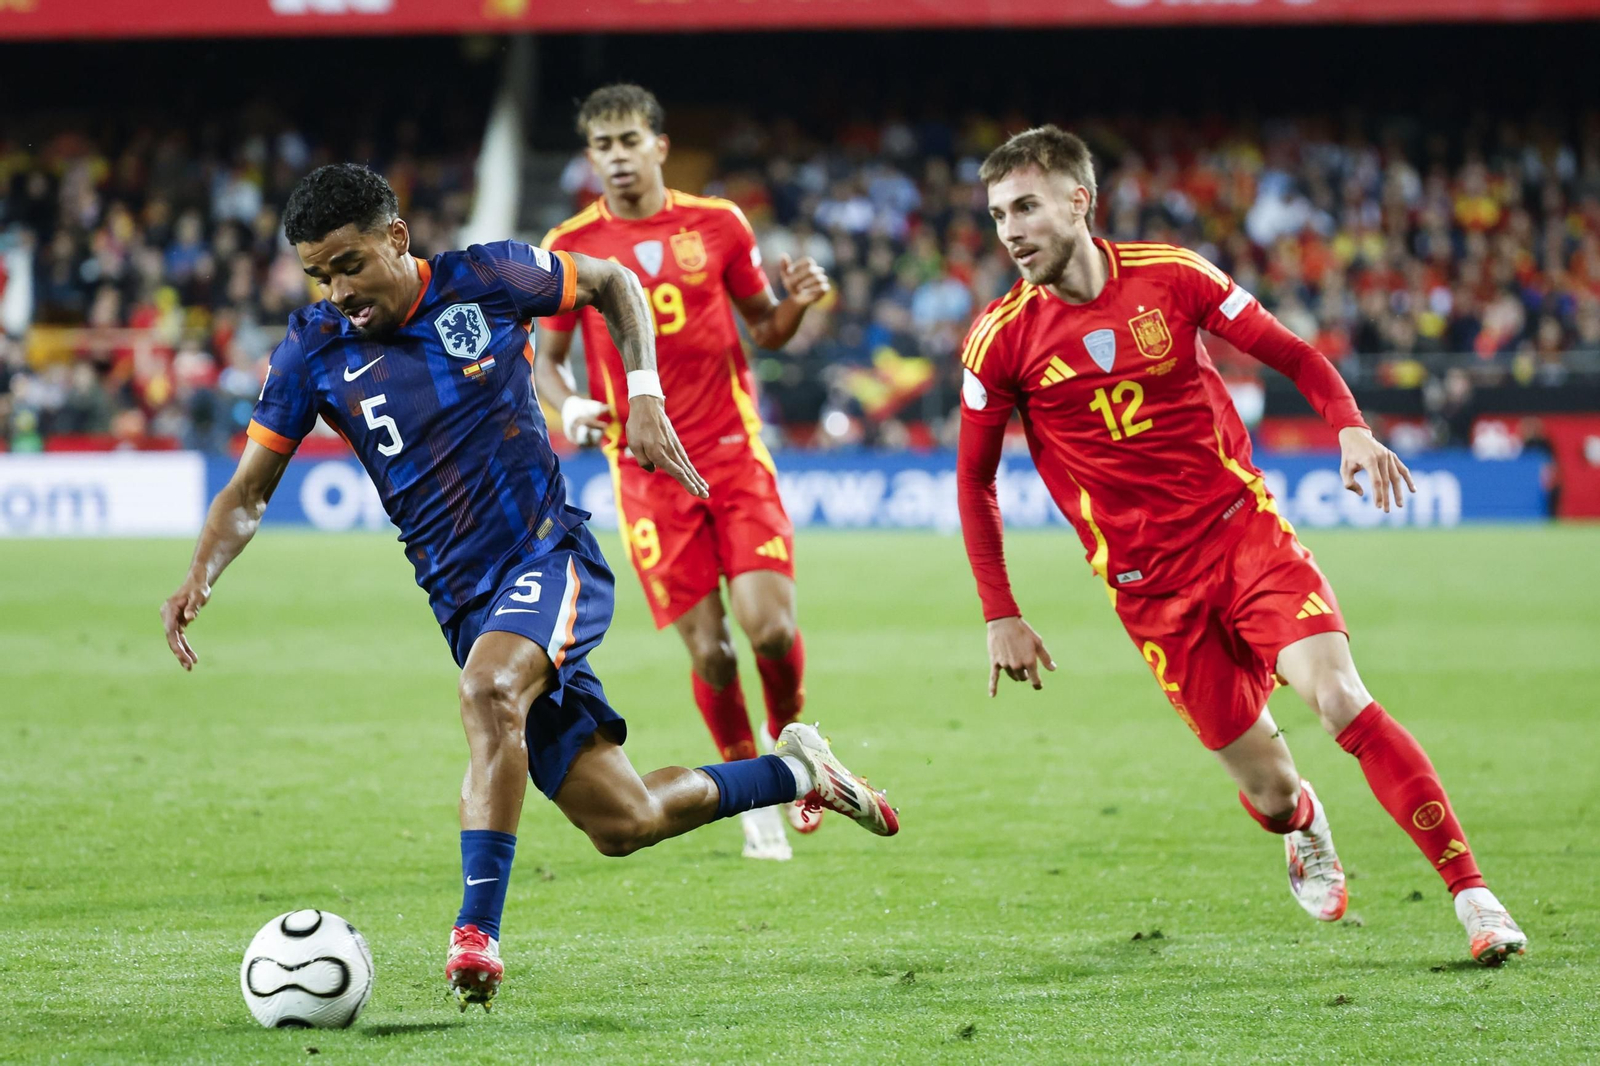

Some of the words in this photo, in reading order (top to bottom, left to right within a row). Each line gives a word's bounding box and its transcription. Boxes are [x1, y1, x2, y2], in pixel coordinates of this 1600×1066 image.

[360, 393, 404, 456] 5
[1089, 380, 1153, 441] 12
[509, 571, 543, 604] 5
